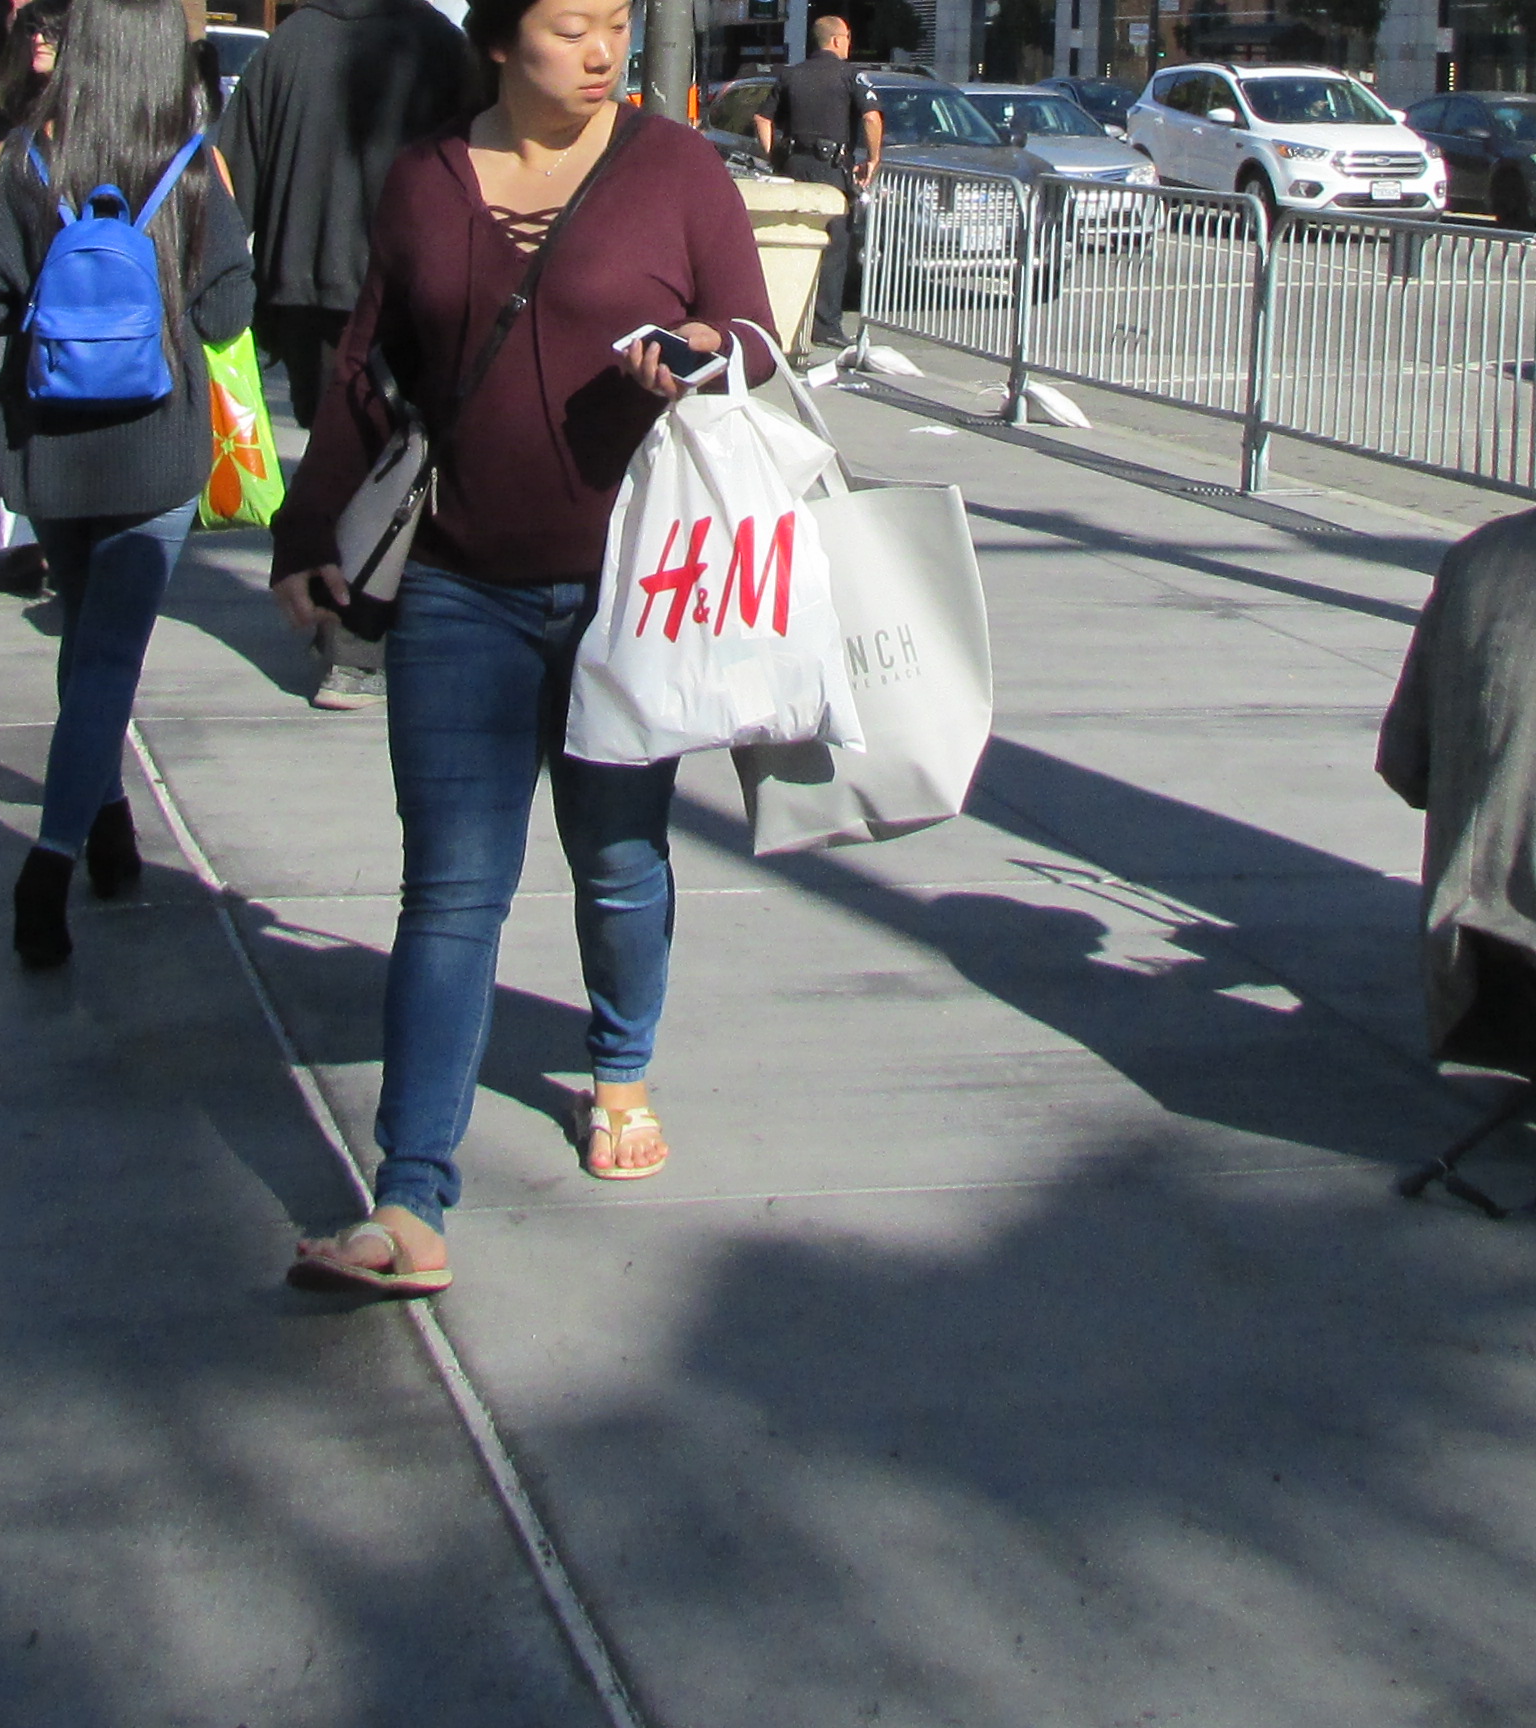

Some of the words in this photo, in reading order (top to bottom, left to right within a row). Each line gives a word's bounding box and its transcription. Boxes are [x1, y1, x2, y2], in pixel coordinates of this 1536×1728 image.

[635, 510, 797, 644] H&M
[845, 623, 918, 677] NCH
[880, 666, 922, 686] BACK
